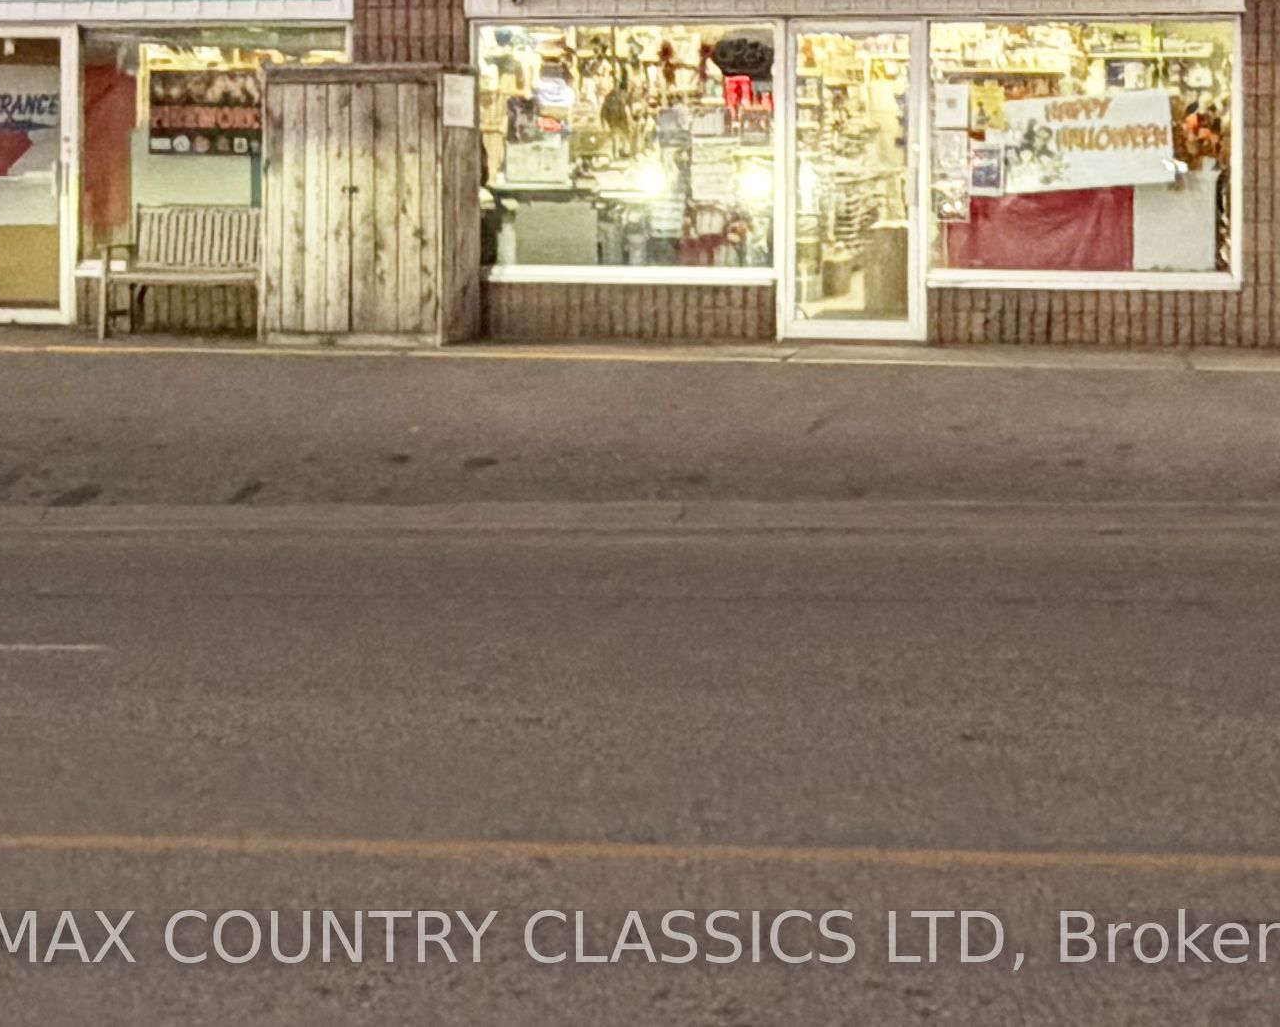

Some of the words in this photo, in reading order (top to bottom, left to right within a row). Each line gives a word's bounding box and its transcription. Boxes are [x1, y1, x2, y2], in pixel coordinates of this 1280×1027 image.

[150, 105, 261, 128] FIREWORK
[1044, 98, 1112, 122] HAPPY
[1056, 125, 1168, 151] HALLOWEEN
